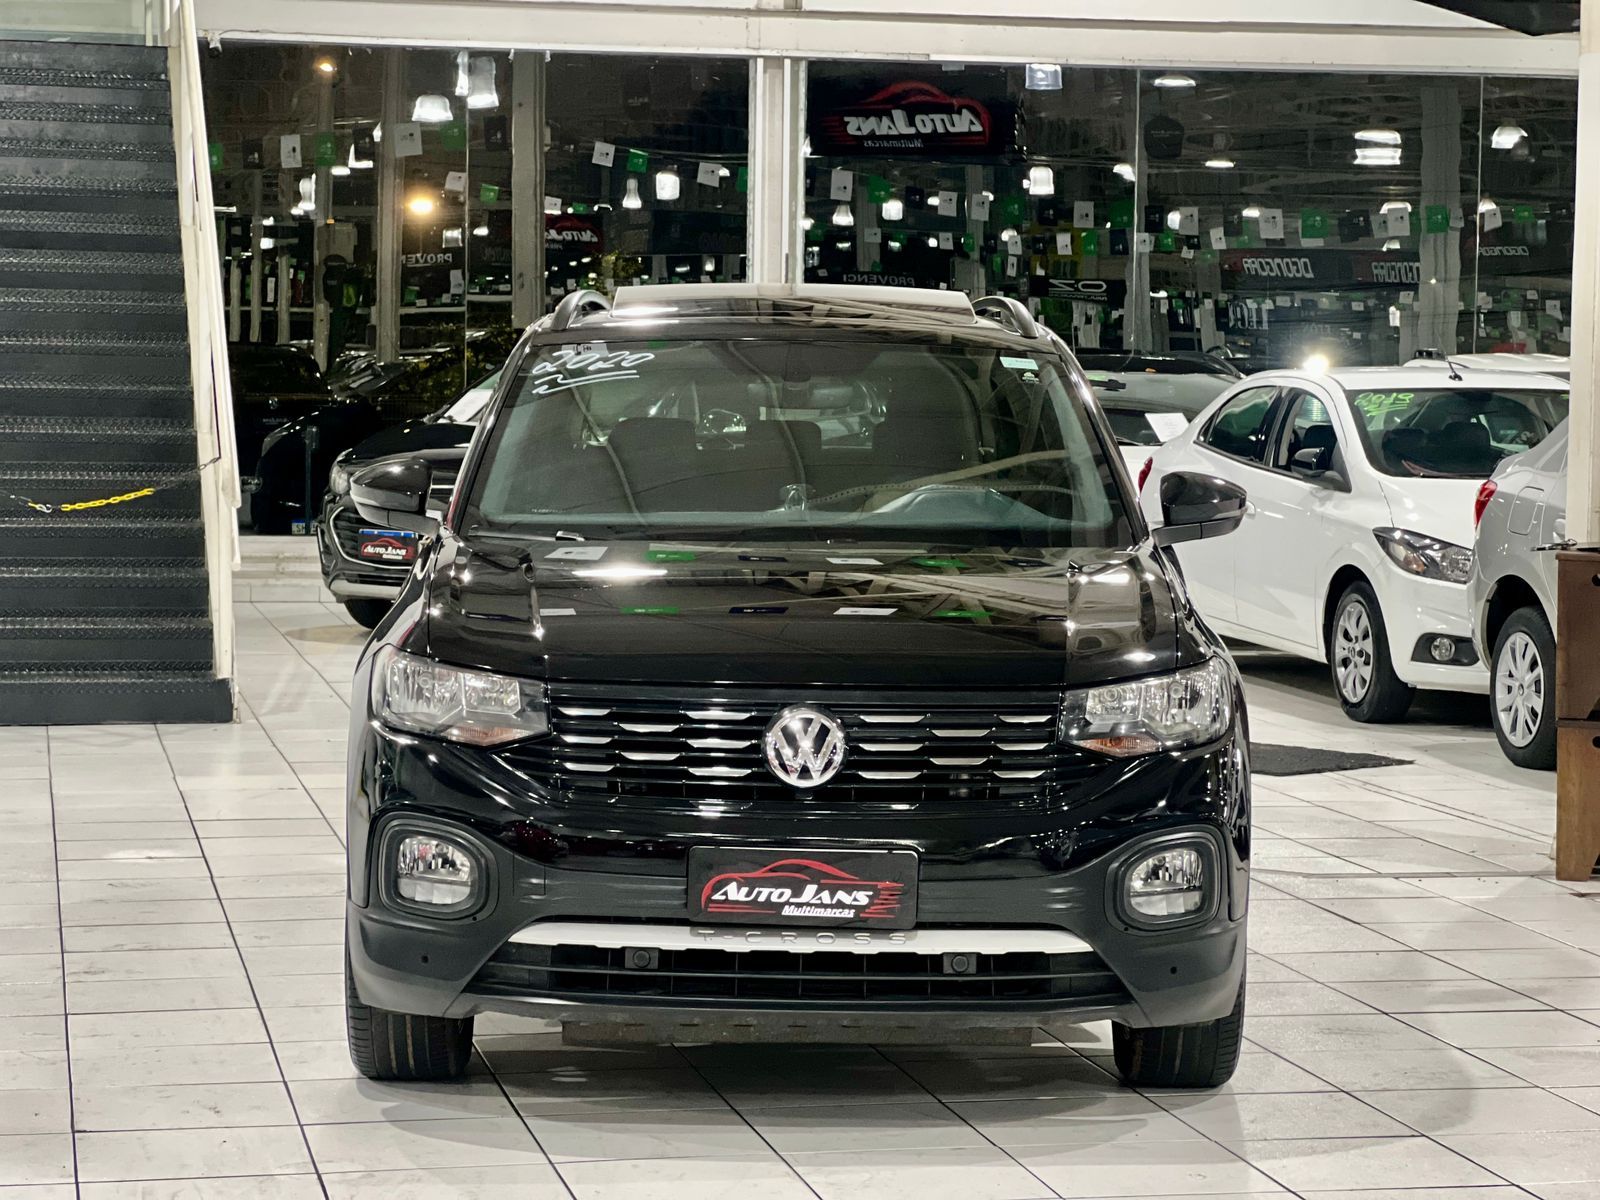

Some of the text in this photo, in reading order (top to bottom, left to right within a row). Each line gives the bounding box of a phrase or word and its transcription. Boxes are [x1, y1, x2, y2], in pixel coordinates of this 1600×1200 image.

[532, 350, 655, 375] 2020
[781, 904, 856, 918] Multimarcas
[698, 929, 906, 945] T-CROSS
